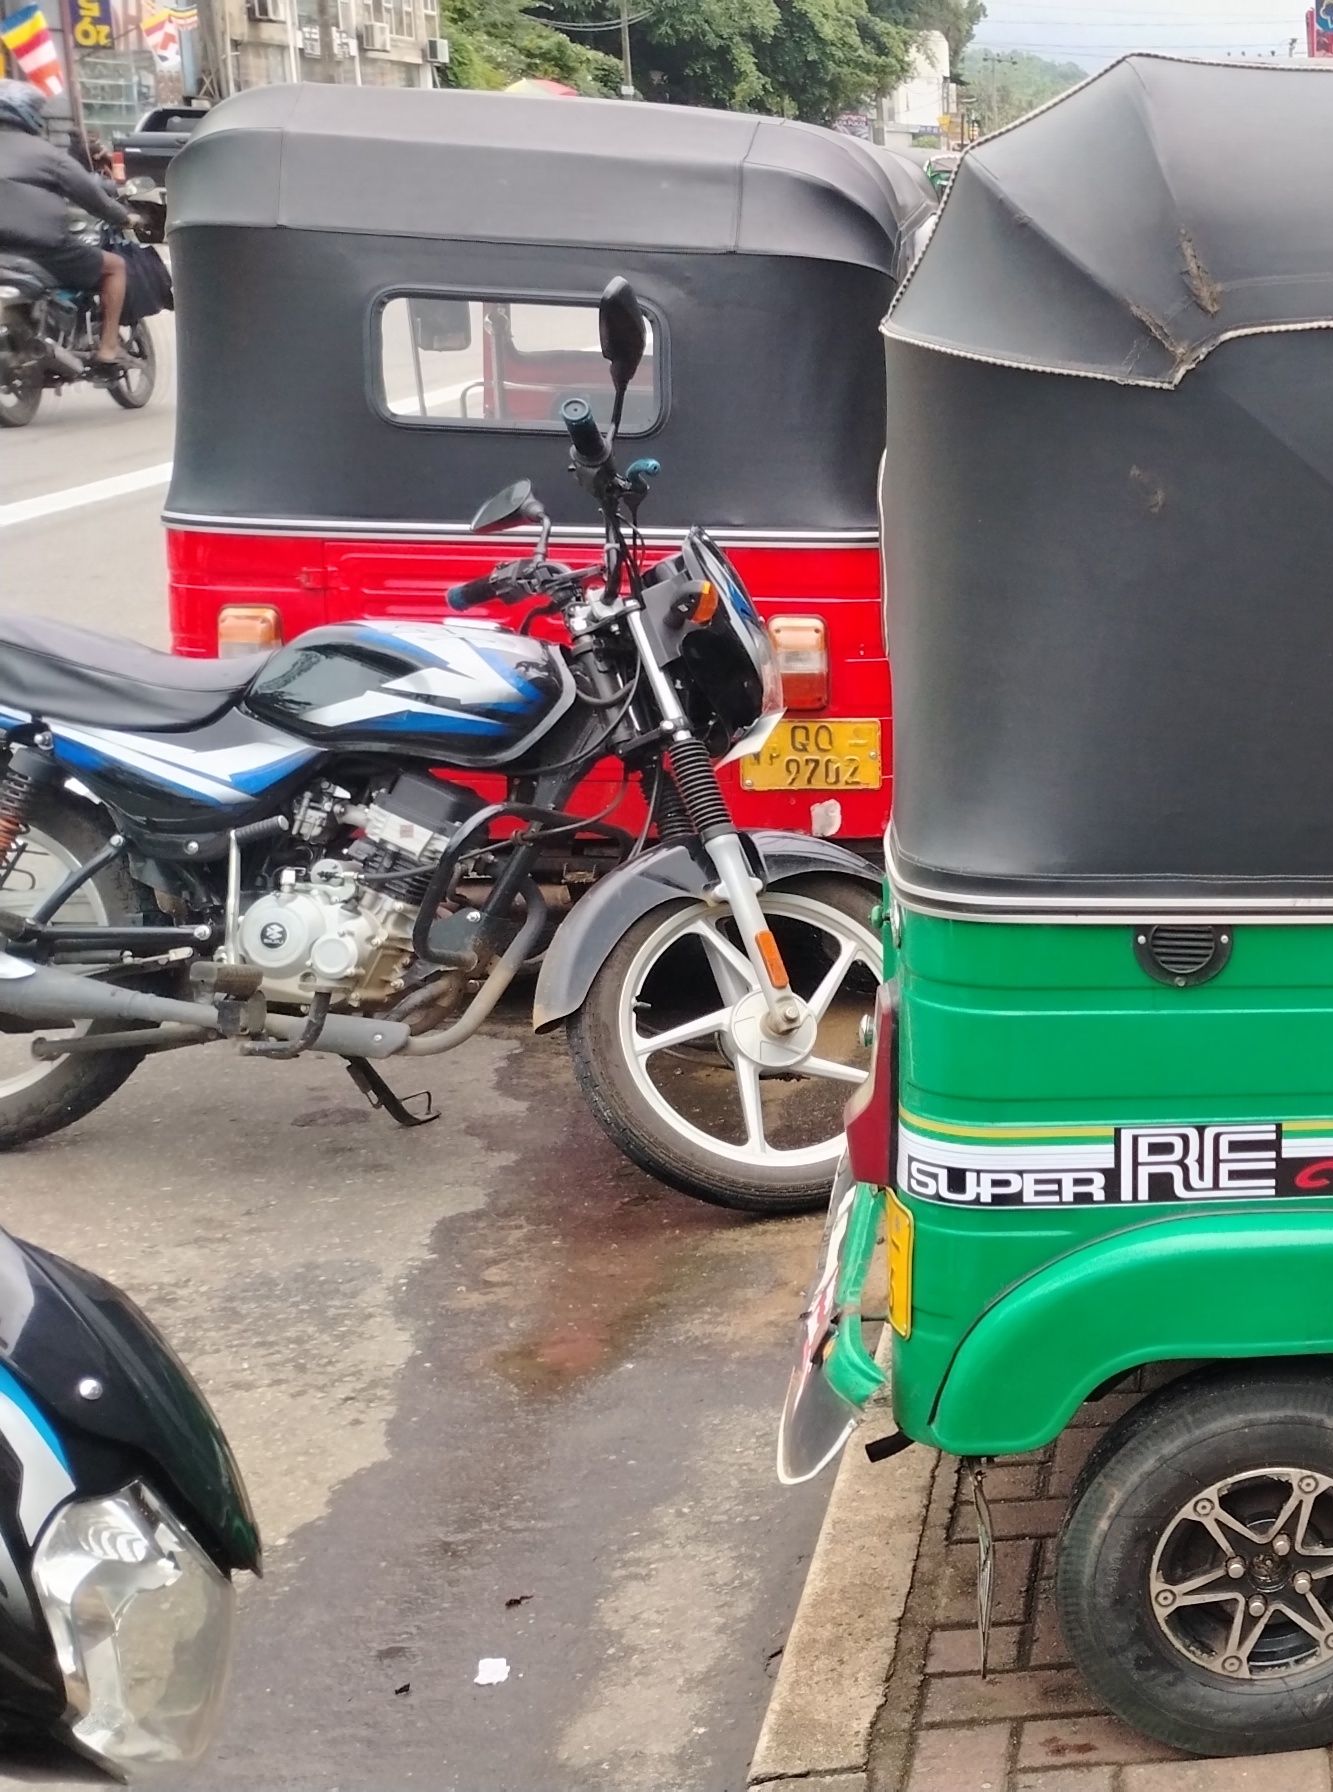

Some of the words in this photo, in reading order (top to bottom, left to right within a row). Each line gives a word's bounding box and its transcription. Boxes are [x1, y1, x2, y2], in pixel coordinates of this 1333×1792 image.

[785, 757, 862, 786] 9702
[909, 1160, 1106, 1204] SUPER
[1120, 1125, 1278, 1202] RE
